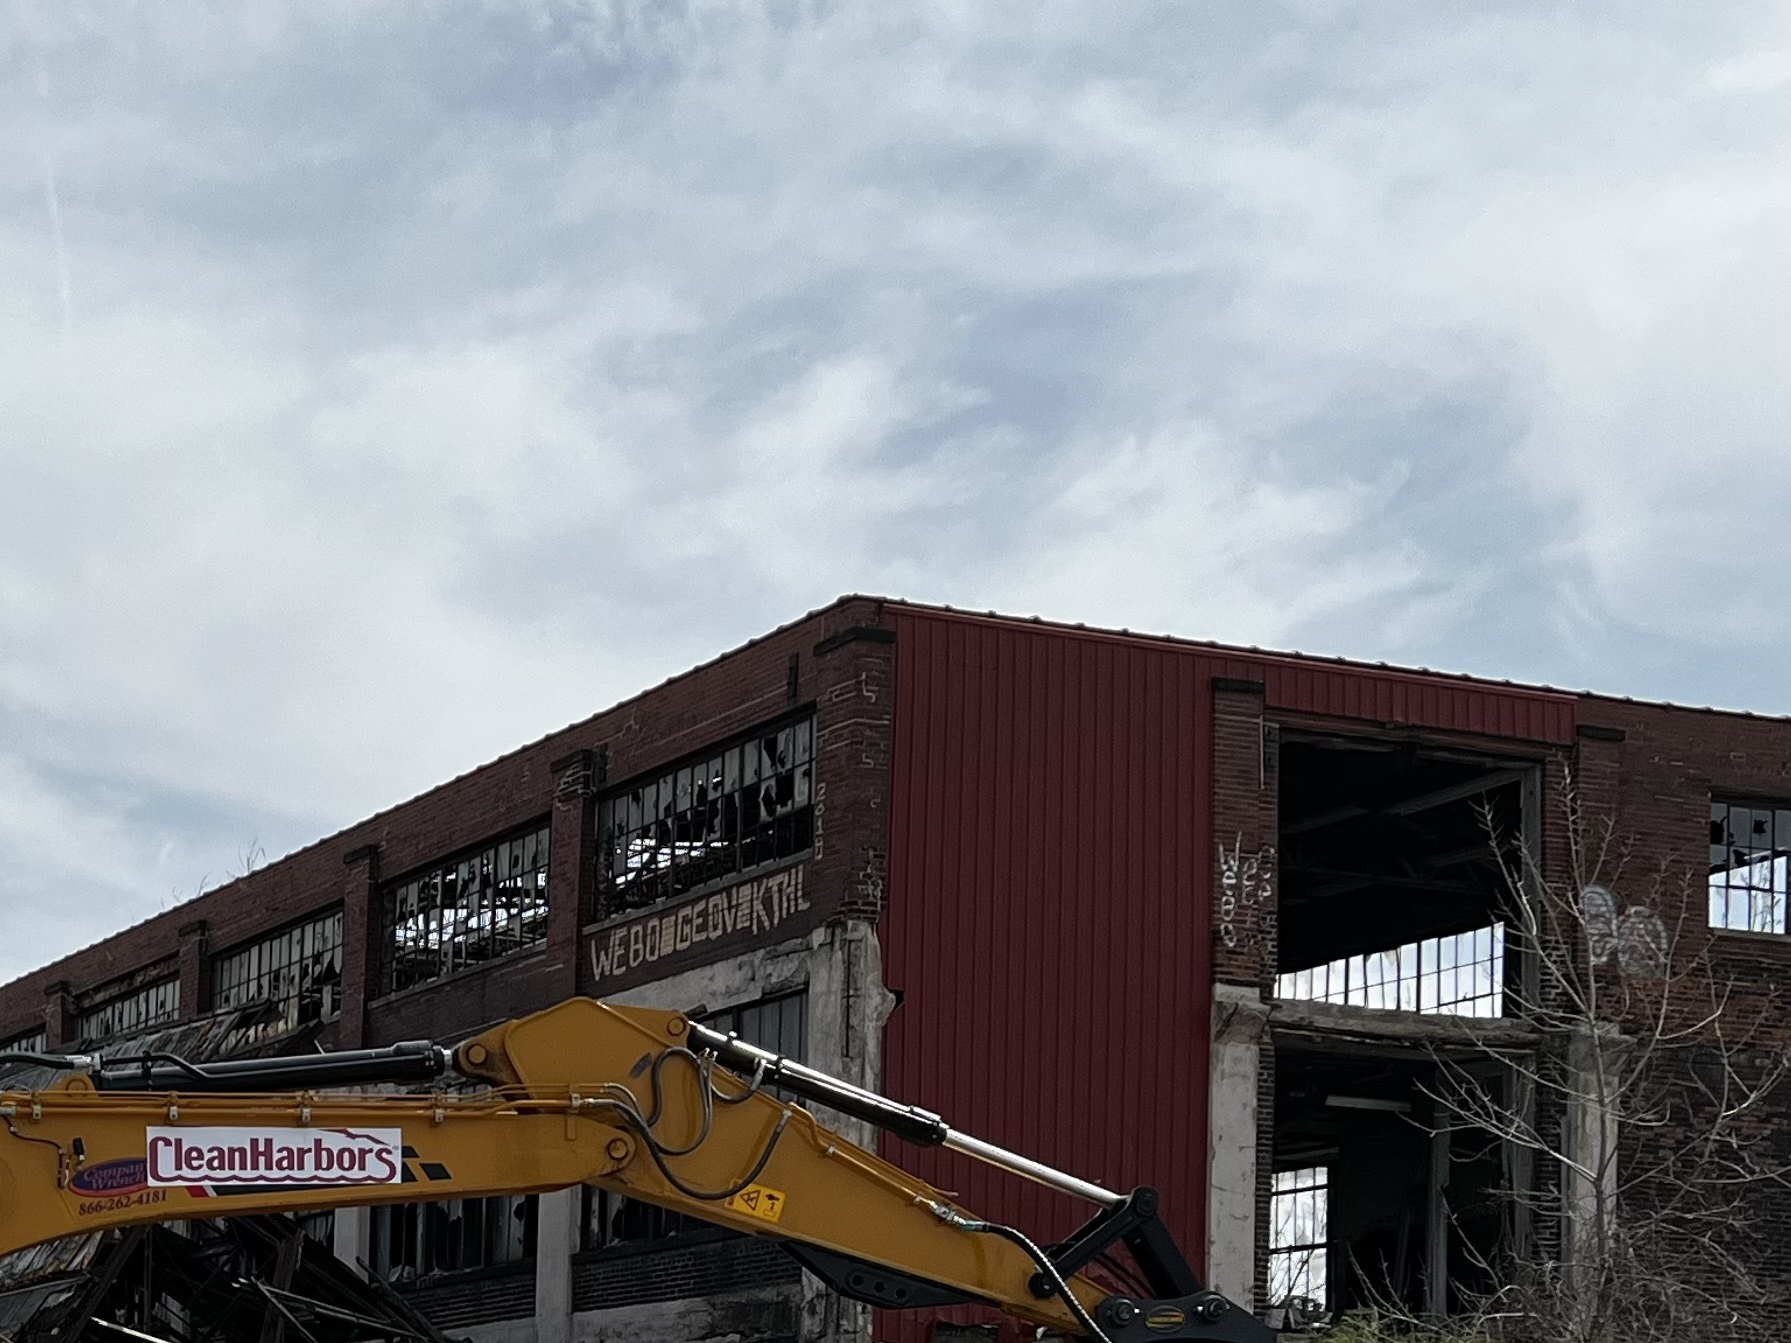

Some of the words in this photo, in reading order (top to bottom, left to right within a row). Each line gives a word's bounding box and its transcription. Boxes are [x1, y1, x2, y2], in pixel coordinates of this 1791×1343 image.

[84, 1164, 146, 1182] Compan
[149, 1136, 397, 1183] CleanHarbors
[78, 1189, 167, 1216] 866-262-4181
